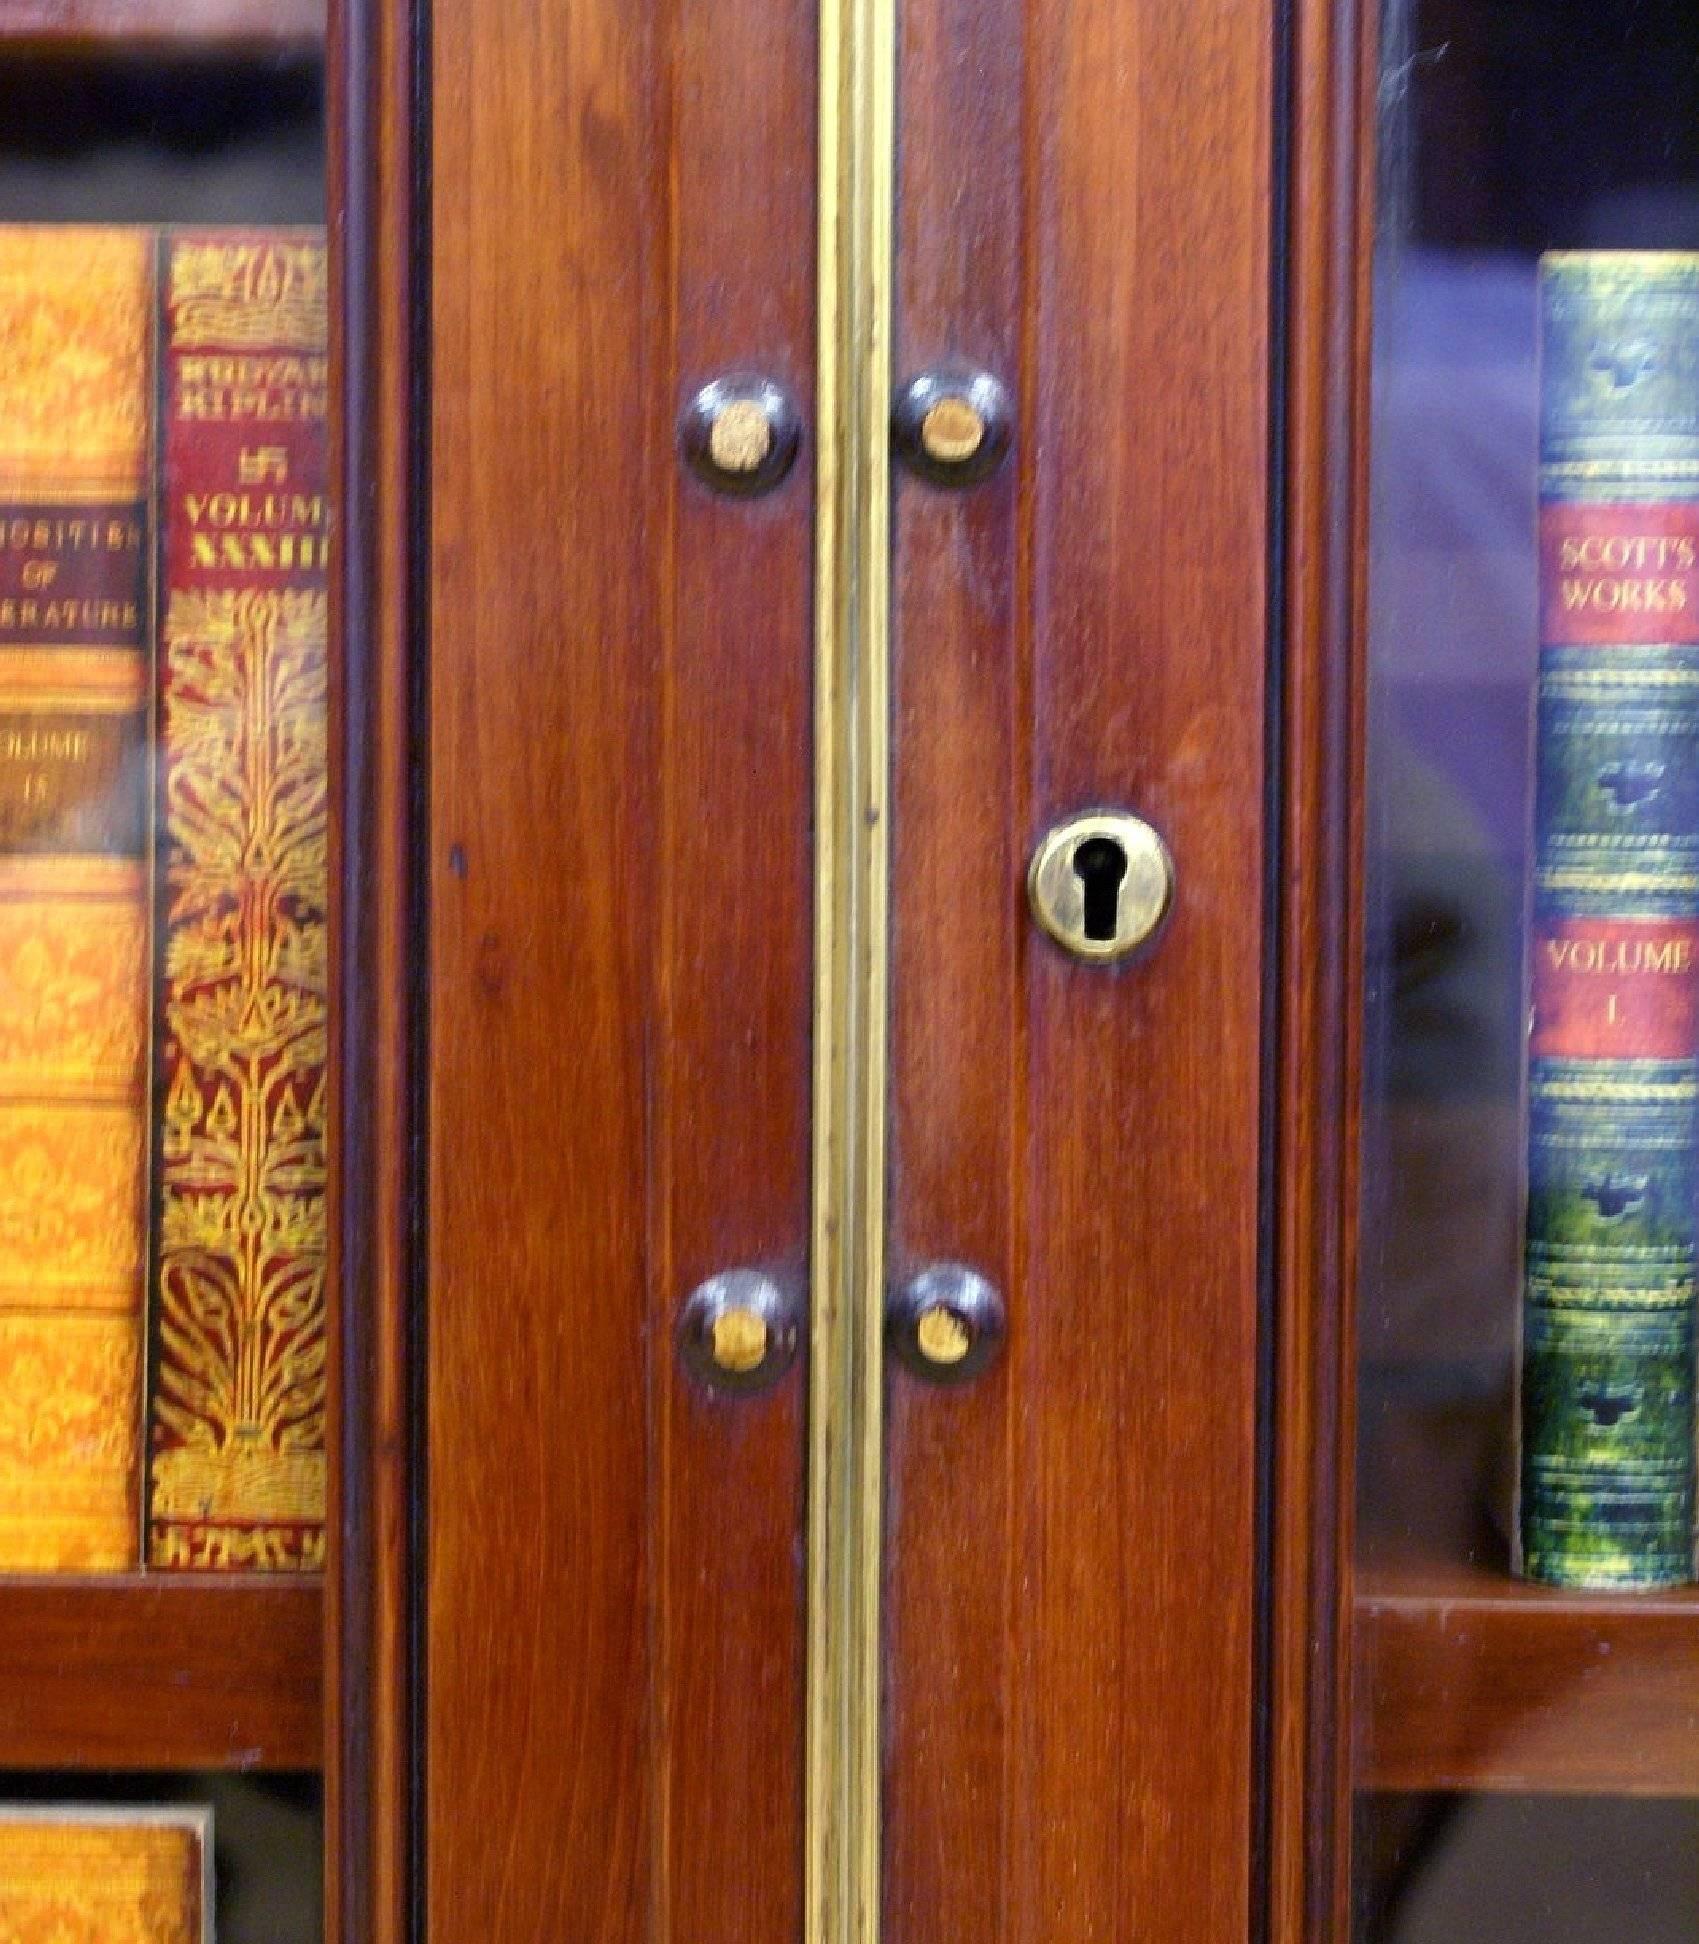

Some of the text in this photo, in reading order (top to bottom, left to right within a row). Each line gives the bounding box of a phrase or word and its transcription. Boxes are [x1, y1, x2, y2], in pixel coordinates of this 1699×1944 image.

[1561, 536, 1695, 570] SCOTT'S
[22, 560, 59, 590] OF
[1562, 579, 1687, 612] WORKS
[1547, 940, 1691, 974] VOLUME
